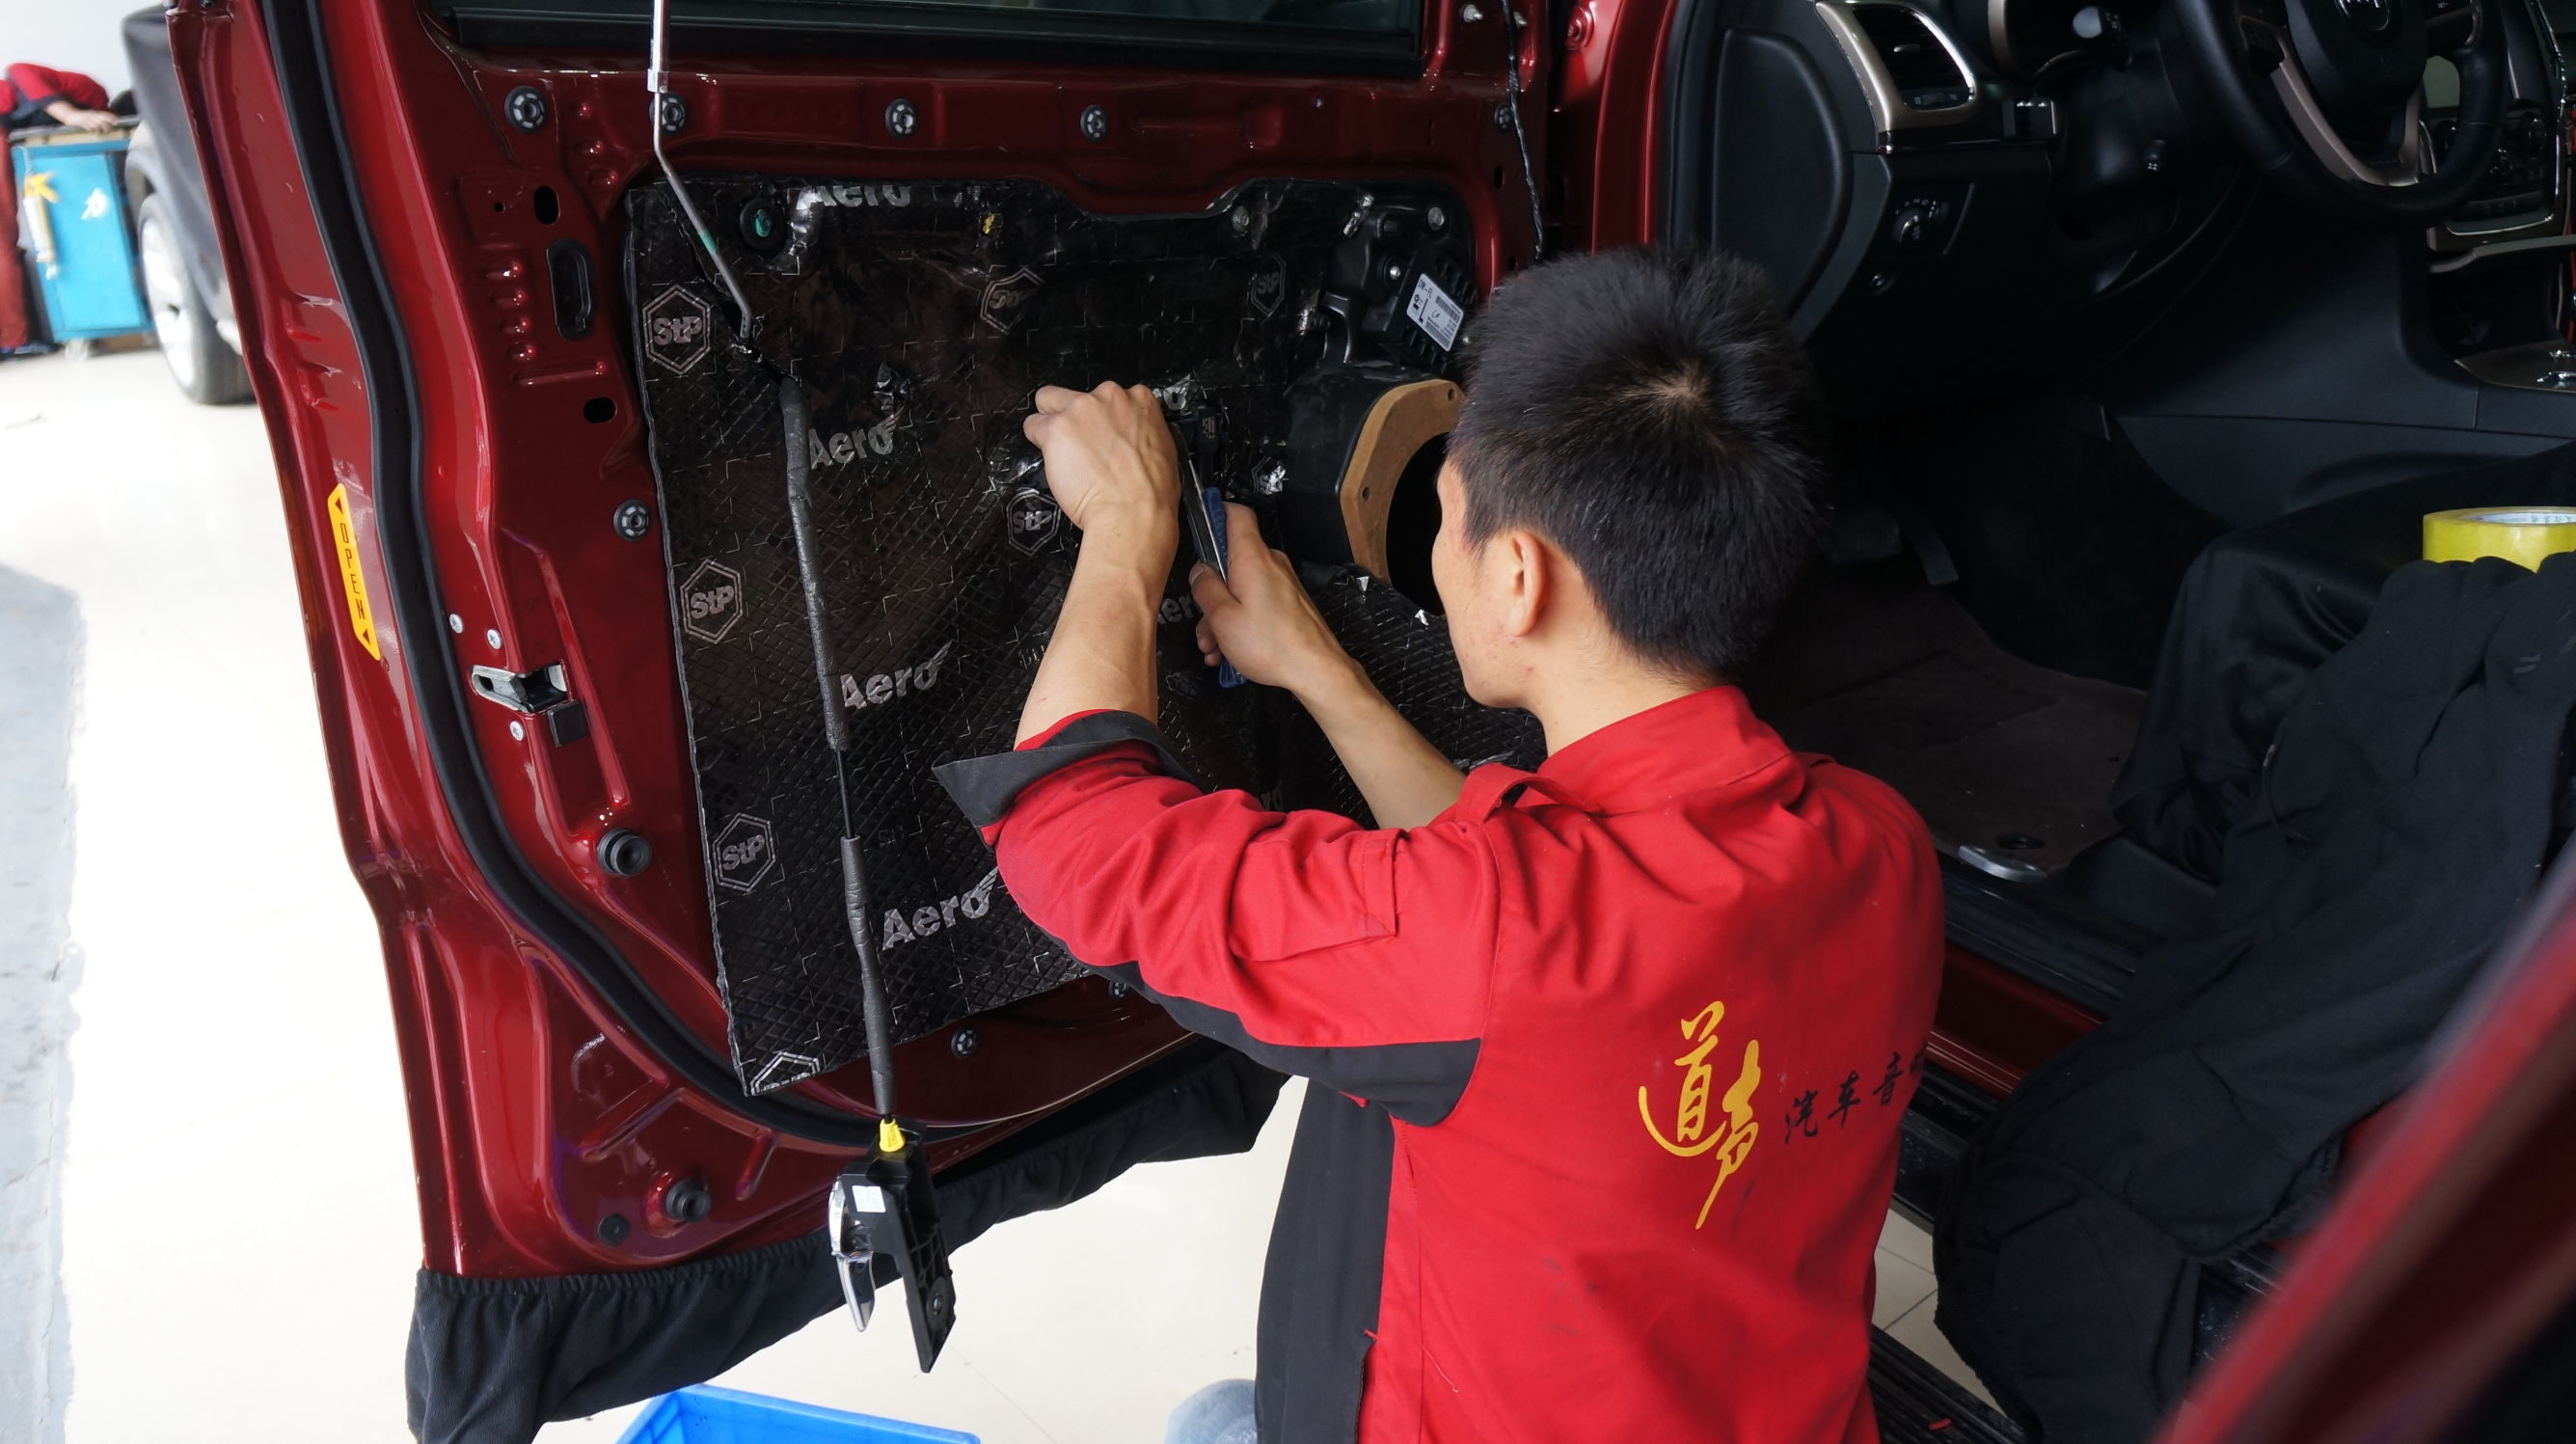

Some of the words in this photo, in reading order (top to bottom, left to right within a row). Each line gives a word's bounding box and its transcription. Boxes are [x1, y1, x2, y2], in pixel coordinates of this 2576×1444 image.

[653, 314, 702, 346] StP
[809, 417, 897, 470] Aero
[1012, 508, 1053, 535] StP
[339, 522, 366, 620] OPEN
[689, 583, 734, 620] StP
[840, 651, 944, 710] Aero
[721, 833, 767, 872] StP
[881, 880, 993, 951] Aero
